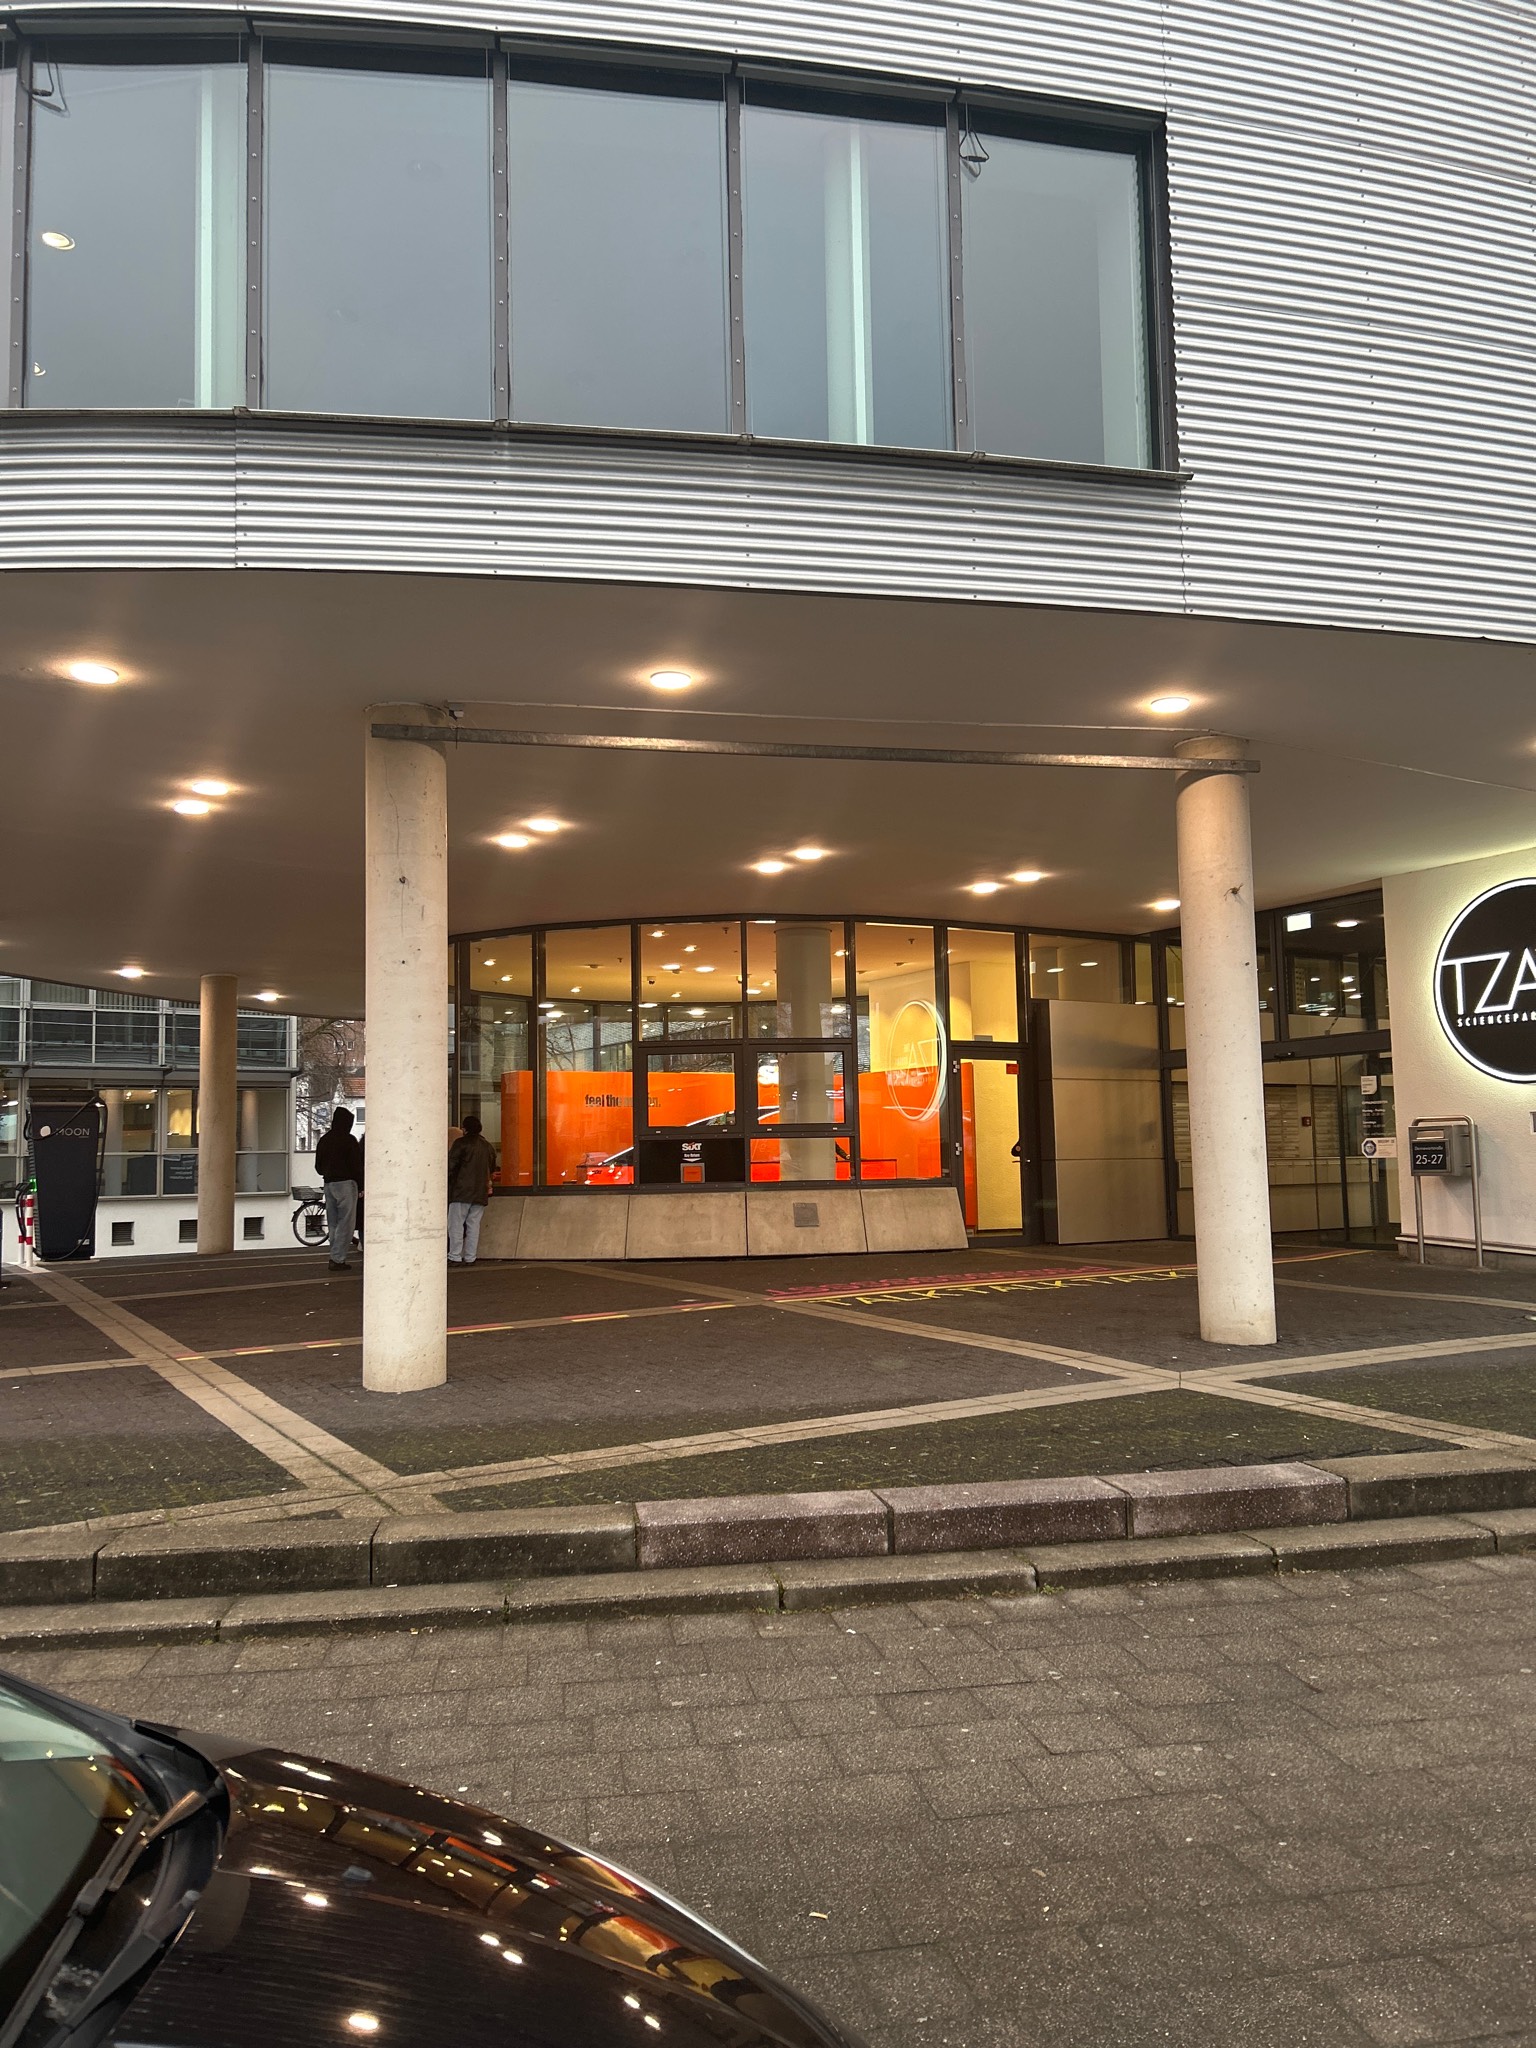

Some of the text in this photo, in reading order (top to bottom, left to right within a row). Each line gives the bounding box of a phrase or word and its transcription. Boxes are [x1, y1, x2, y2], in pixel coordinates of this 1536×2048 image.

[585, 1094, 605, 1107] feel
[606, 1094, 621, 1107] the
[55, 1127, 90, 1136] MOON
[1415, 1154, 1443, 1165] 25-27
